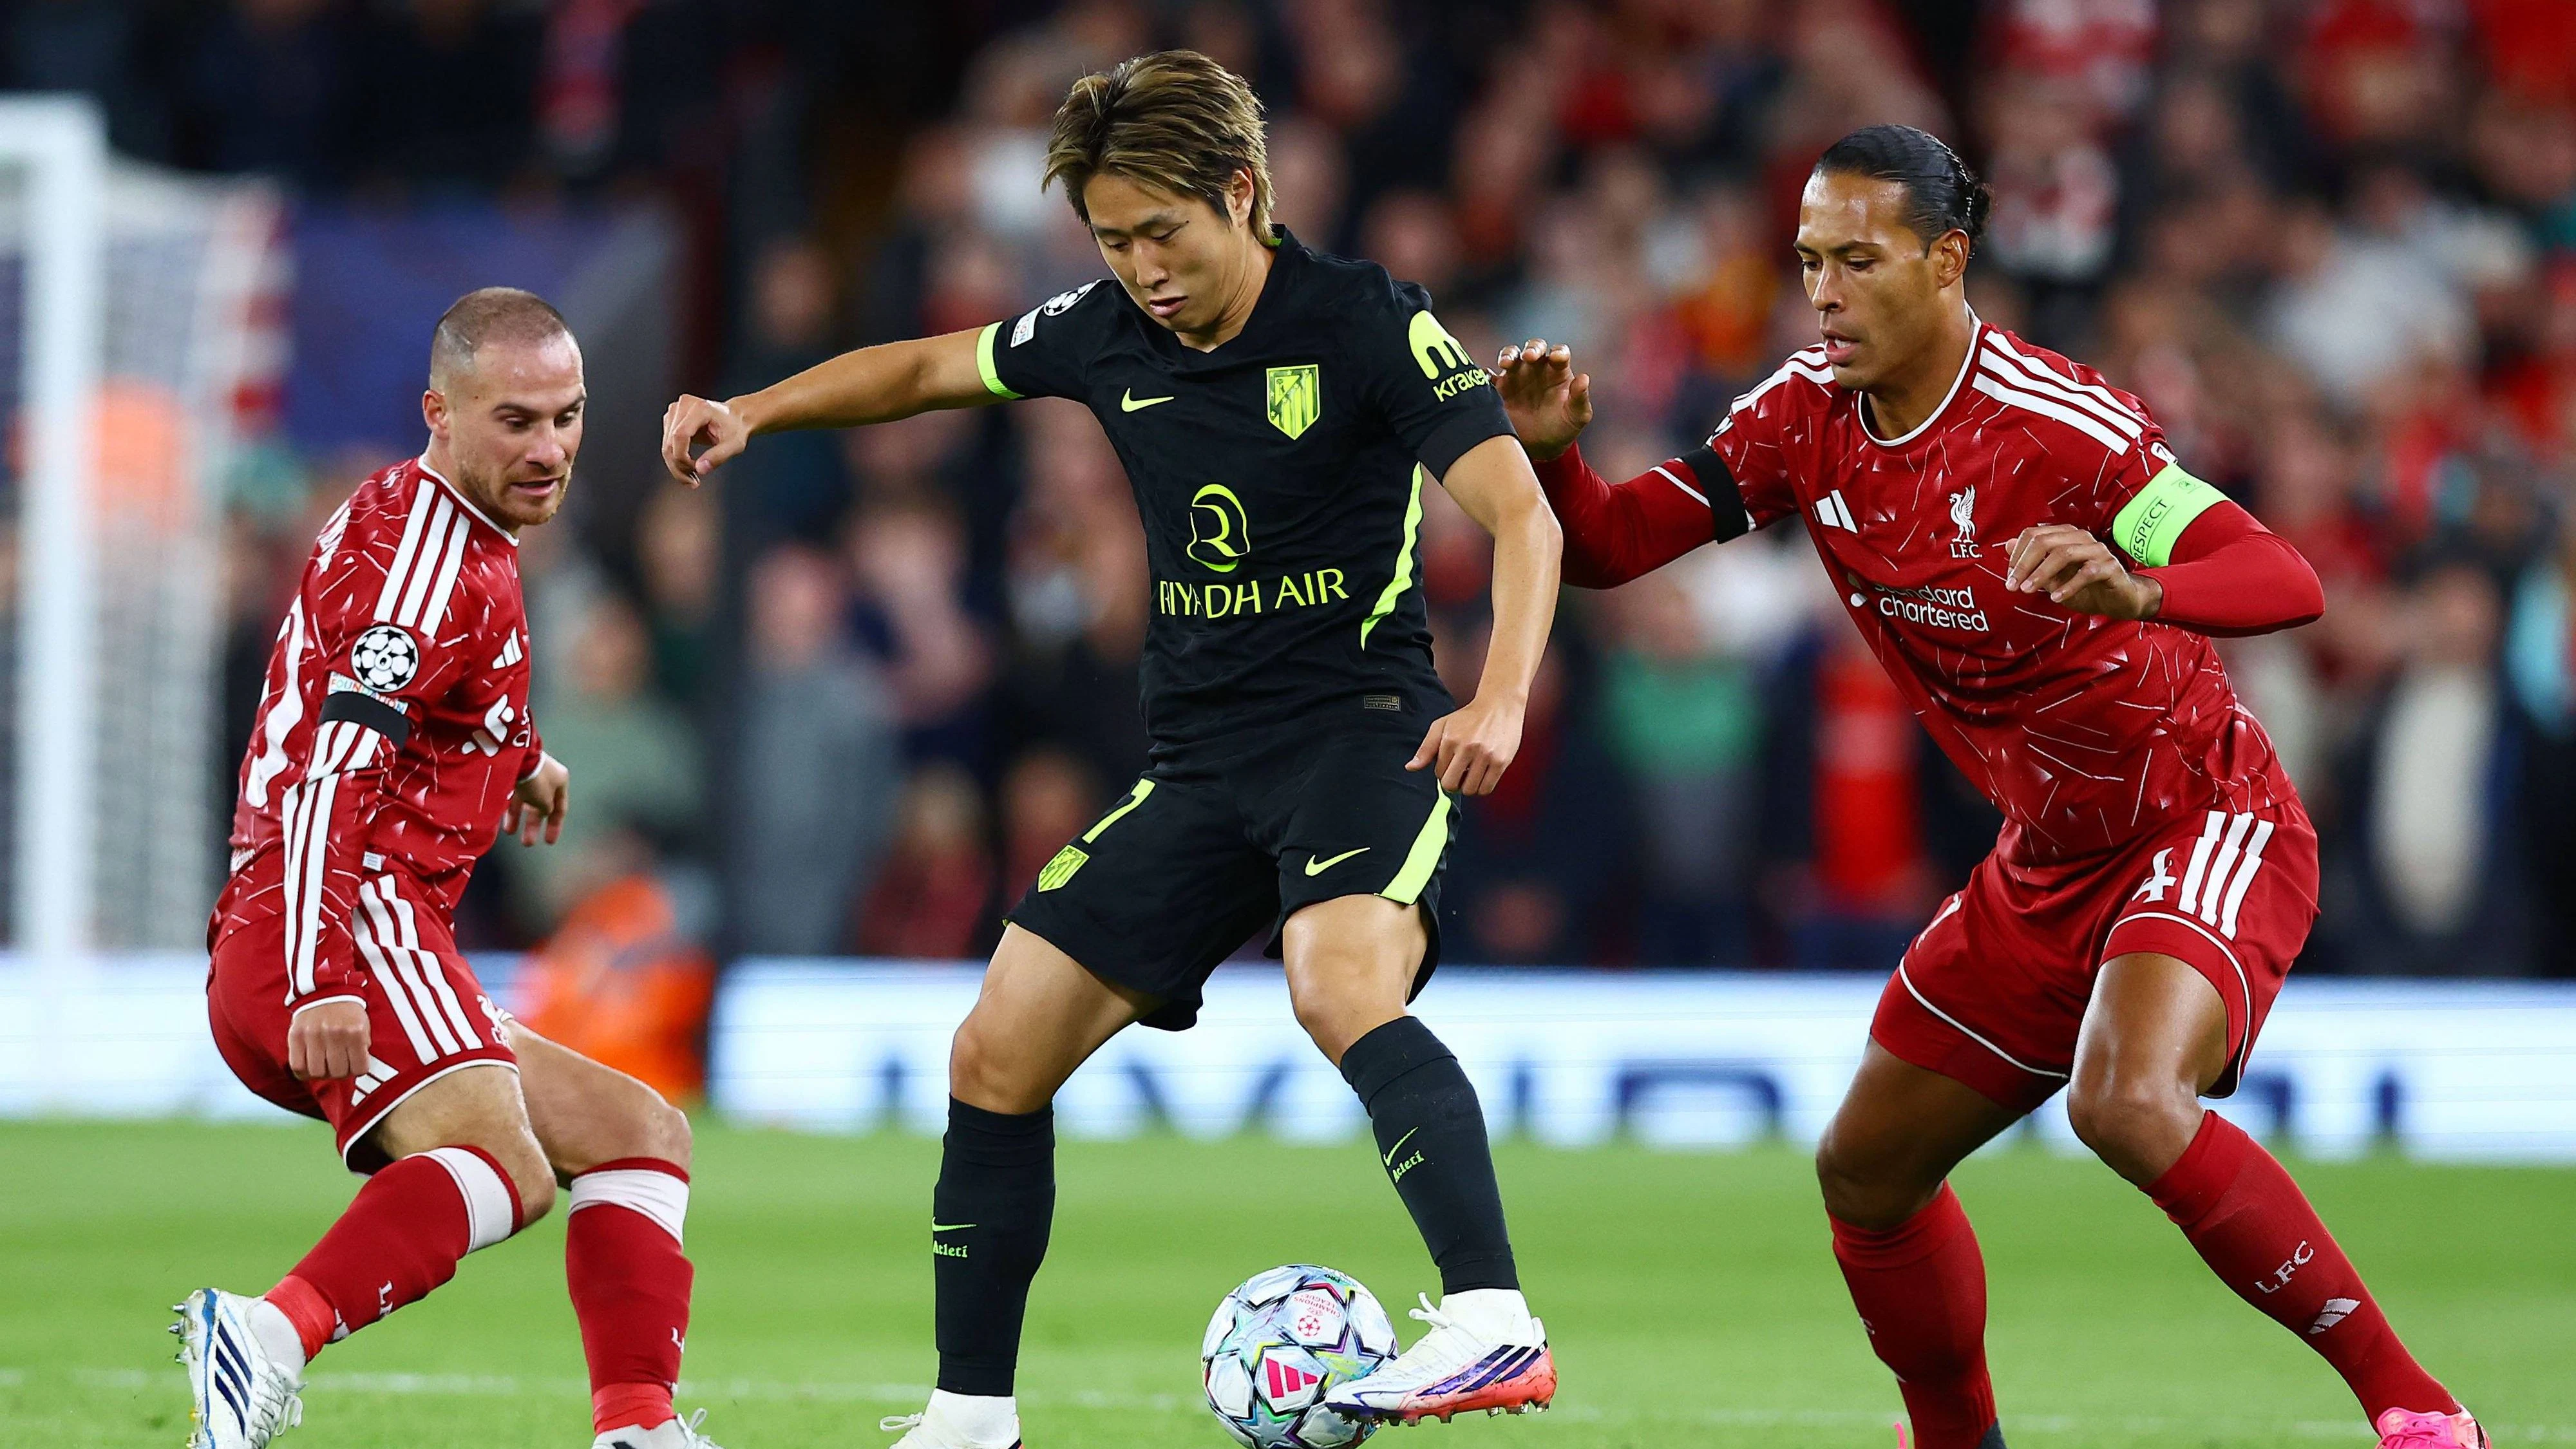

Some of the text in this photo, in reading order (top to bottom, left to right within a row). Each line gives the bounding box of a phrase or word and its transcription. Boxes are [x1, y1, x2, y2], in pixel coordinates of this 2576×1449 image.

[2133, 498, 2168, 564] RESPECT
[1160, 568, 1350, 619] RIYADH AIR
[1879, 594, 1990, 632] chartered
[2132, 846, 2177, 904] 4
[2255, 1240, 2315, 1294] LFC
[1294, 1296, 1341, 1318] CHAMPIONS
